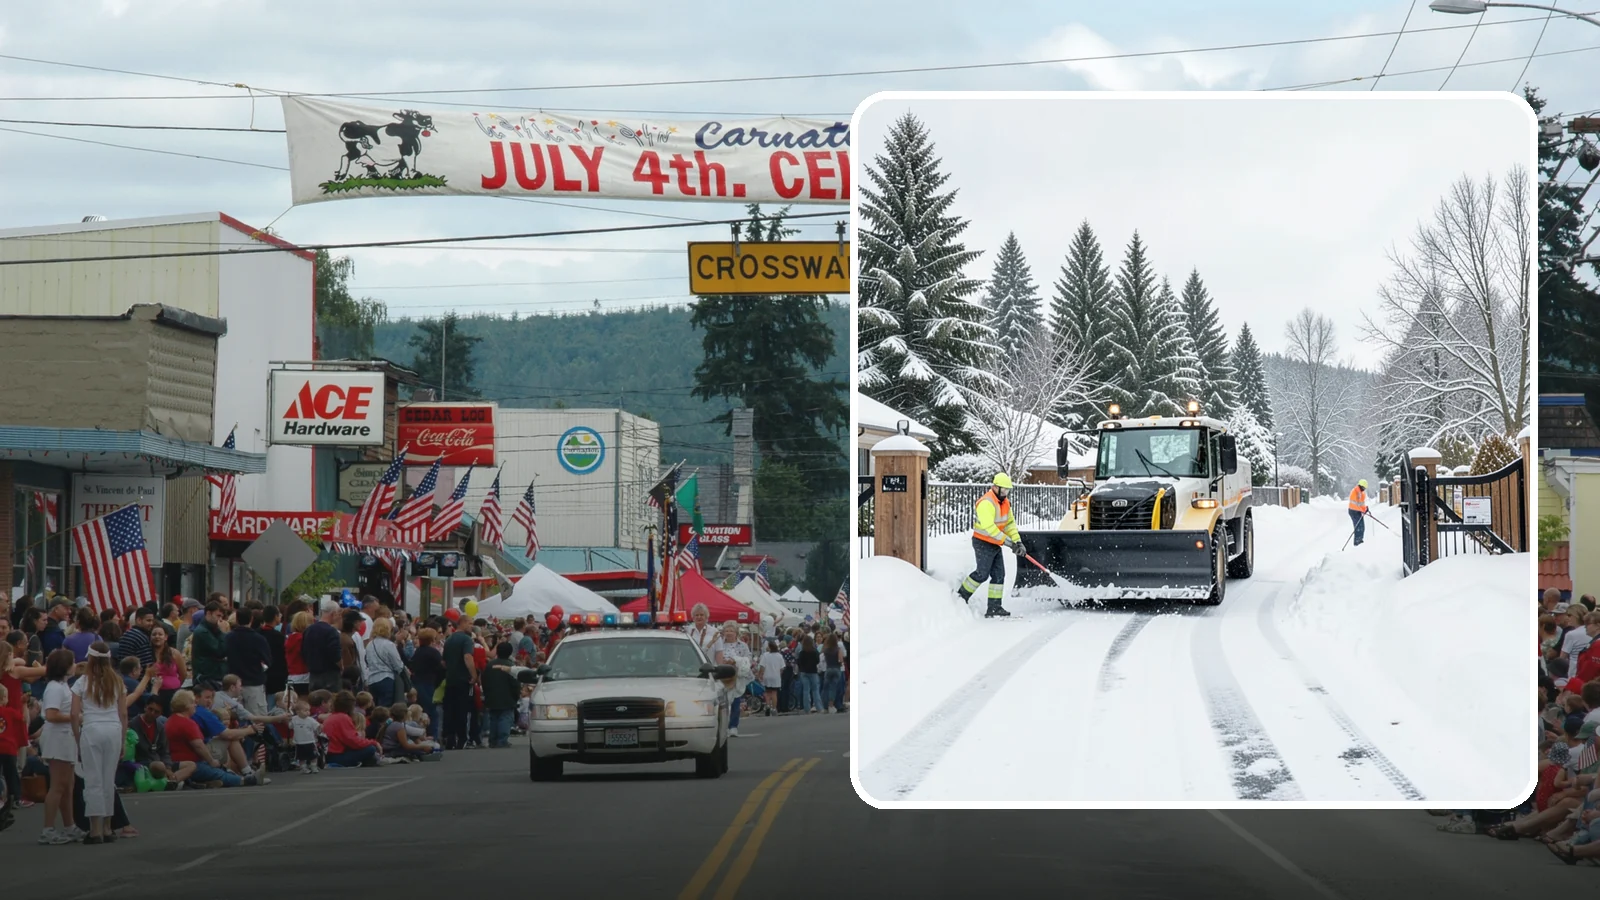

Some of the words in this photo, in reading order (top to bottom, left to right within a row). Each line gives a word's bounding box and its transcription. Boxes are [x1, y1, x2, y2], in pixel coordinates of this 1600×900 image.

[694, 121, 850, 150] Carnat
[481, 141, 604, 192] JULY
[632, 150, 746, 198] 4th.
[697, 254, 850, 280] CROSSWA
[282, 380, 374, 420] ACE
[405, 409, 453, 423] CEDAR
[283, 421, 371, 437] Hardware
[416, 428, 477, 447] Coca-Cola
[353, 467, 386, 481] Simpl
[83, 485, 94, 494] St.
[96, 485, 124, 494] Vincent
[126, 486, 136, 495] de
[138, 485, 155, 495] Paul
[688, 526, 742, 535] CRNATION
[699, 535, 730, 543] GLASS
